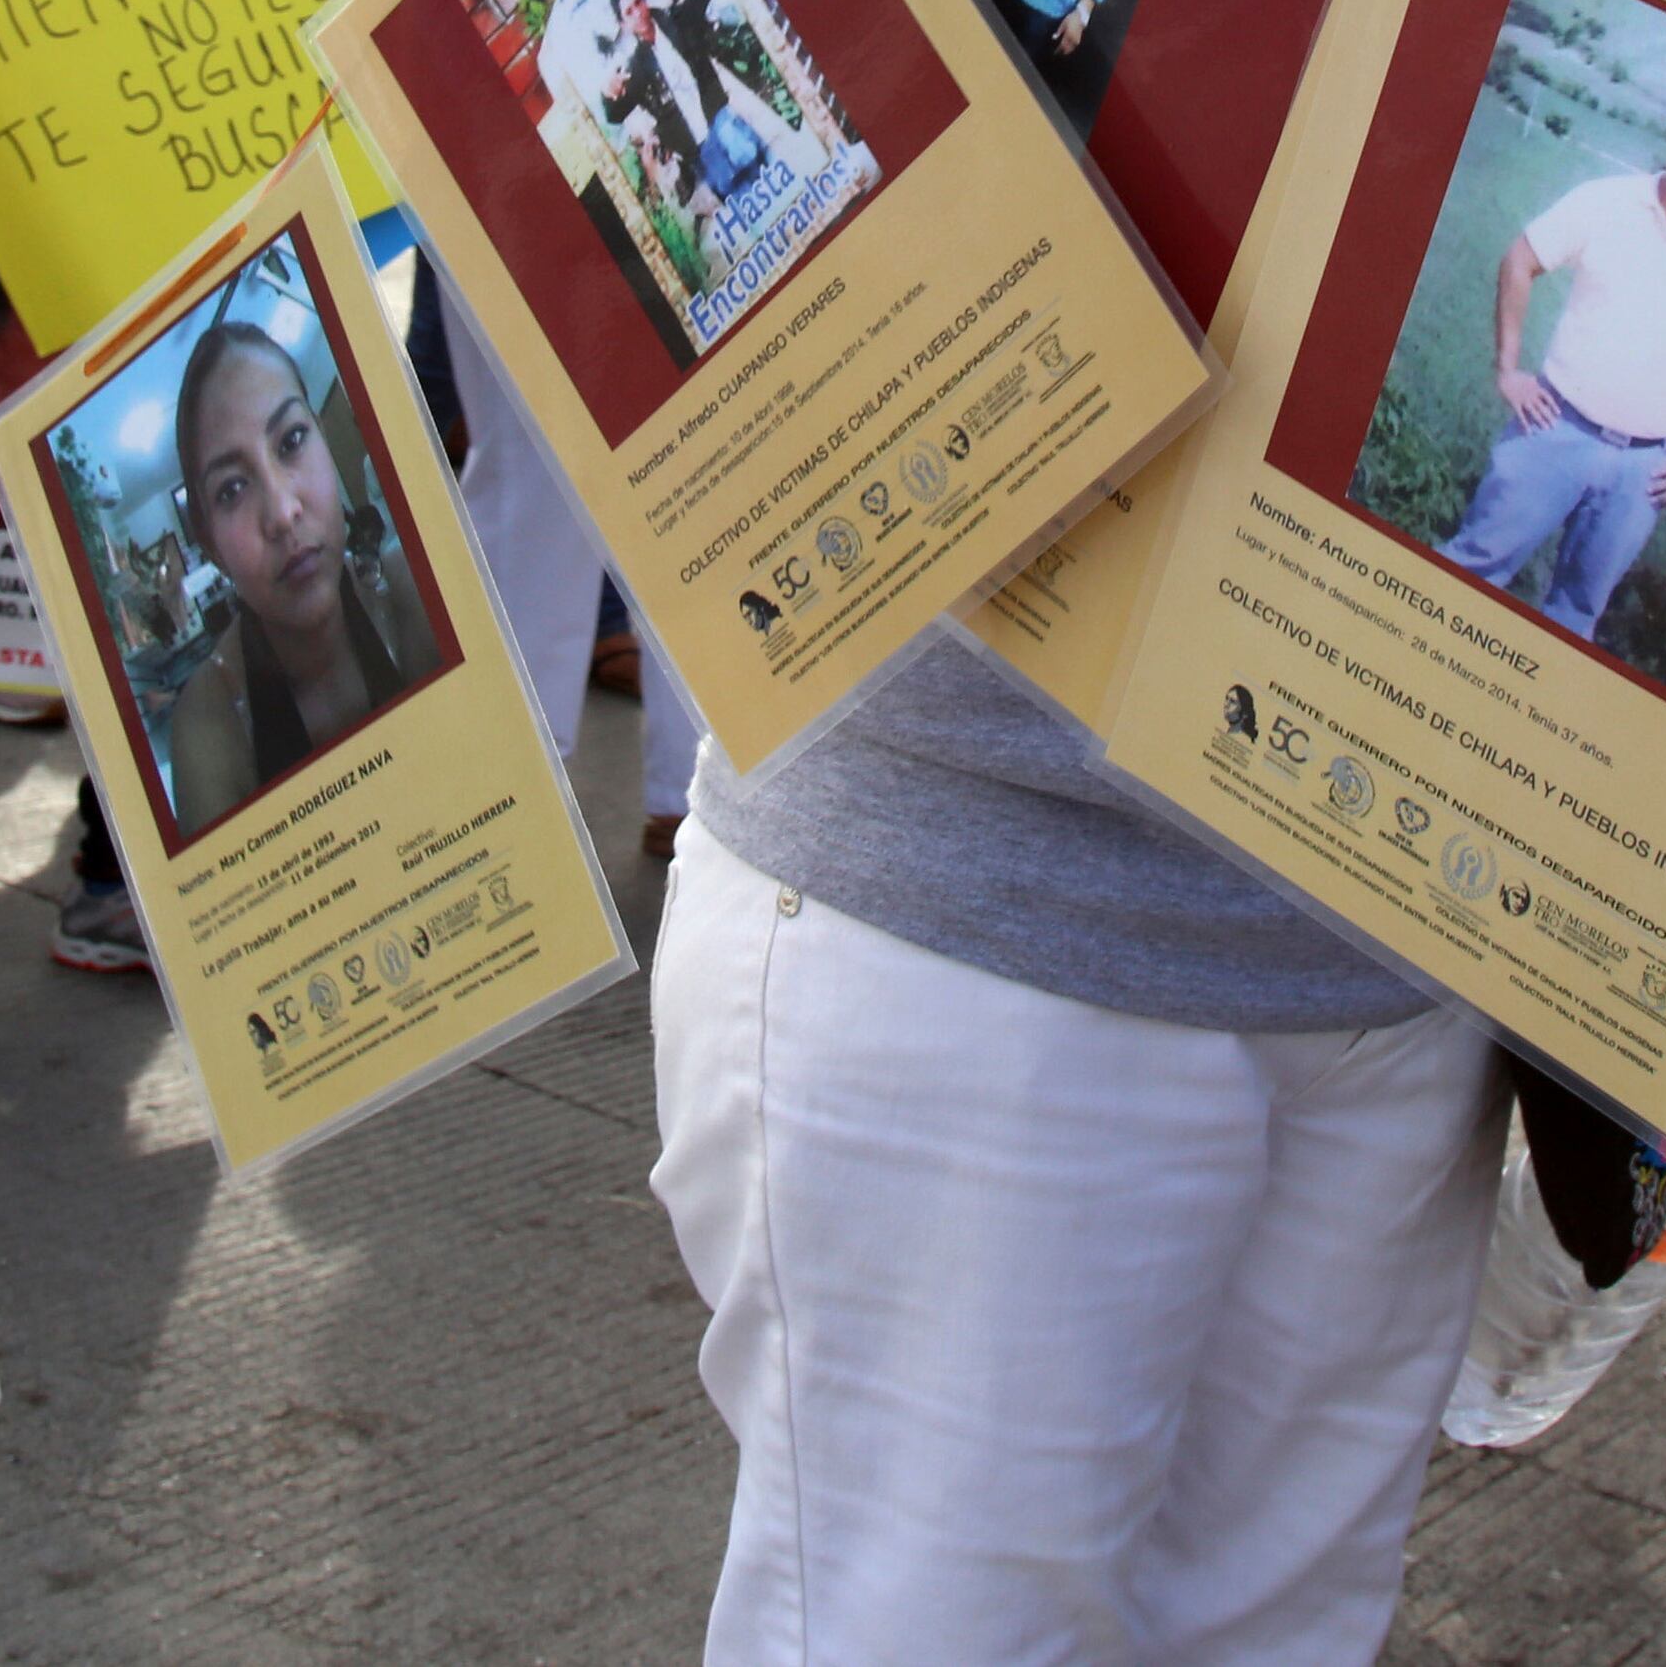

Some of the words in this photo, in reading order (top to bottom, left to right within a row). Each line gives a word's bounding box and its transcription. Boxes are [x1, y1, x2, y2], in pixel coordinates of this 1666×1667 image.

[119, 15, 314, 136] SEGUI
[627, 439, 678, 488] Nombre:
[678, 400, 719, 444] Alfredo
[718, 332, 787, 403] CUAPANGO
[785, 276, 845, 337] VERARES
[679, 515, 750, 584] COLECTIVO
[748, 497, 770, 522] DE
[767, 444, 829, 503] VICTIMAS
[827, 425, 849, 451] DE
[847, 376, 904, 432] CHILAPA
[900, 362, 913, 380] Y
[913, 306, 977, 371] PUEBLOS
[976, 236, 1052, 312] INDIGENAS
[1249, 491, 1315, 544] Nombre:
[1318, 537, 1368, 576] Arturo
[1373, 569, 1444, 624] ORTEGA
[1449, 615, 1539, 679] SANCHEZ
[218, 847, 245, 871] Mary
[246, 819, 288, 853] Carmen
[288, 770, 357, 825] RODRÍGUEZ
[357, 748, 393, 779] NAVA
[1218, 578, 1312, 647] COLECTIVO
[1314, 639, 1339, 666] DE
[1345, 656, 1426, 719] VICTIMAS
[1429, 711, 1455, 739] DE
[1459, 730, 1535, 790] CHILAPA
[1544, 780, 1556, 798] Y
[1558, 791, 1650, 858] PUEBLOS
[1268, 680, 1323, 723] FRENTE
[1327, 719, 1411, 777] GUERRERO
[1414, 774, 1448, 802] POR
[1451, 798, 1536, 858] NUESTROS
[401, 851, 423, 872] Raúl
[423, 823, 469, 858] TRUJILLO
[470, 795, 516, 830] HERRERA
